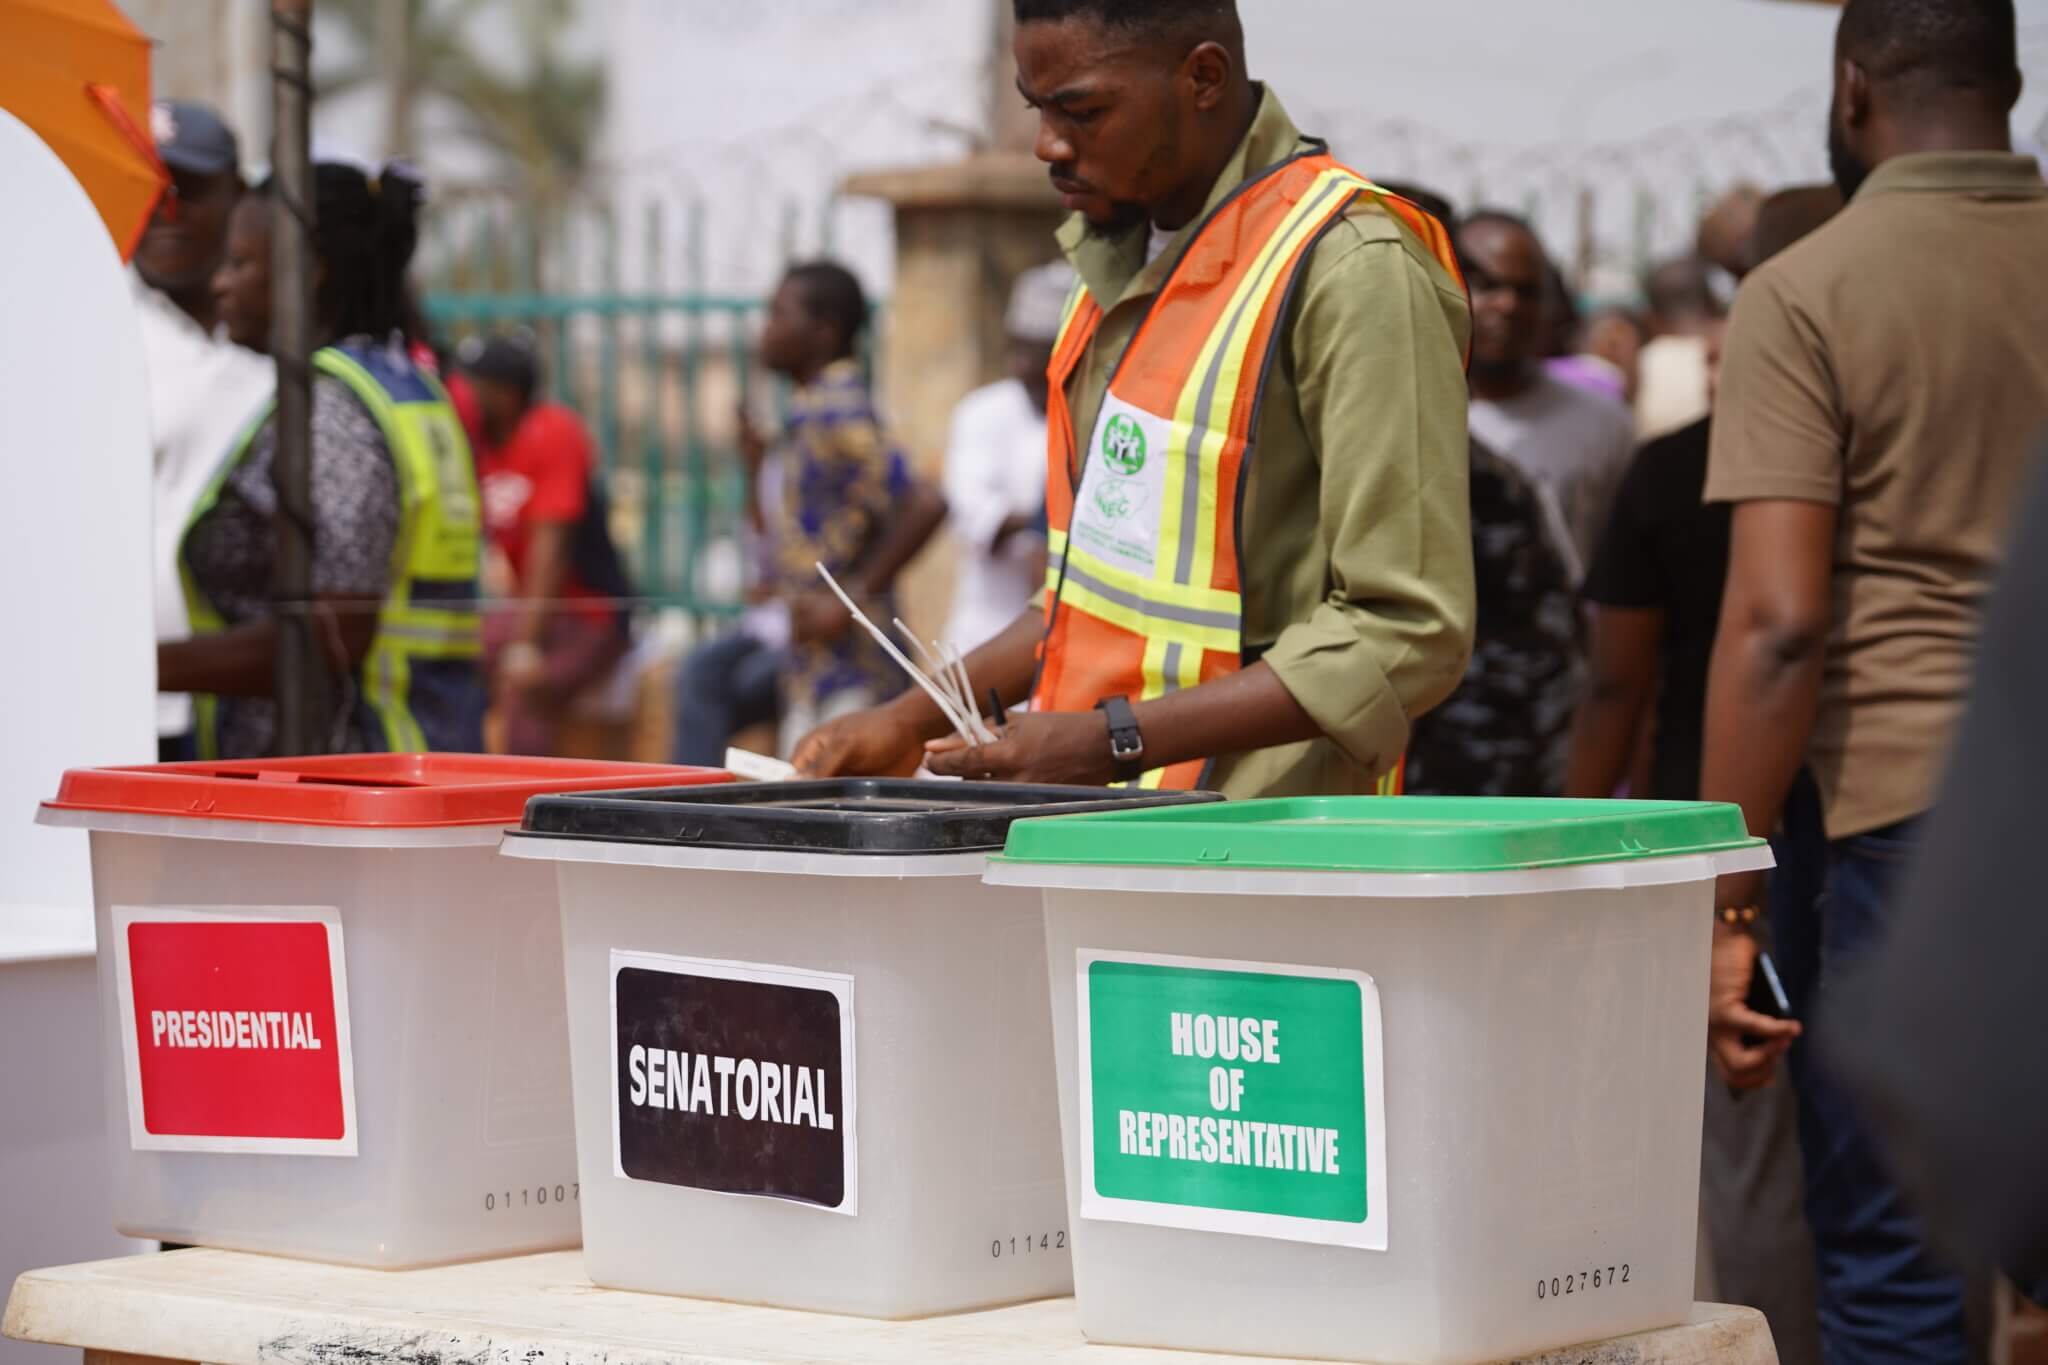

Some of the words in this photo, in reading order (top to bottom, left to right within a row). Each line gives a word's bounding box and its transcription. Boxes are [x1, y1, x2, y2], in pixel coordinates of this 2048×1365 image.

[151, 1010, 321, 1049] PRESIDENTIAL
[1171, 1012, 1280, 1064] HOUSE
[629, 1045, 834, 1130] SENATORIAL
[1209, 1067, 1244, 1112] OF
[1119, 1110, 1340, 1175] REPRESENTATIVE
[992, 1230, 1065, 1258] 01142
[1538, 1263, 1629, 1298] 0027672
